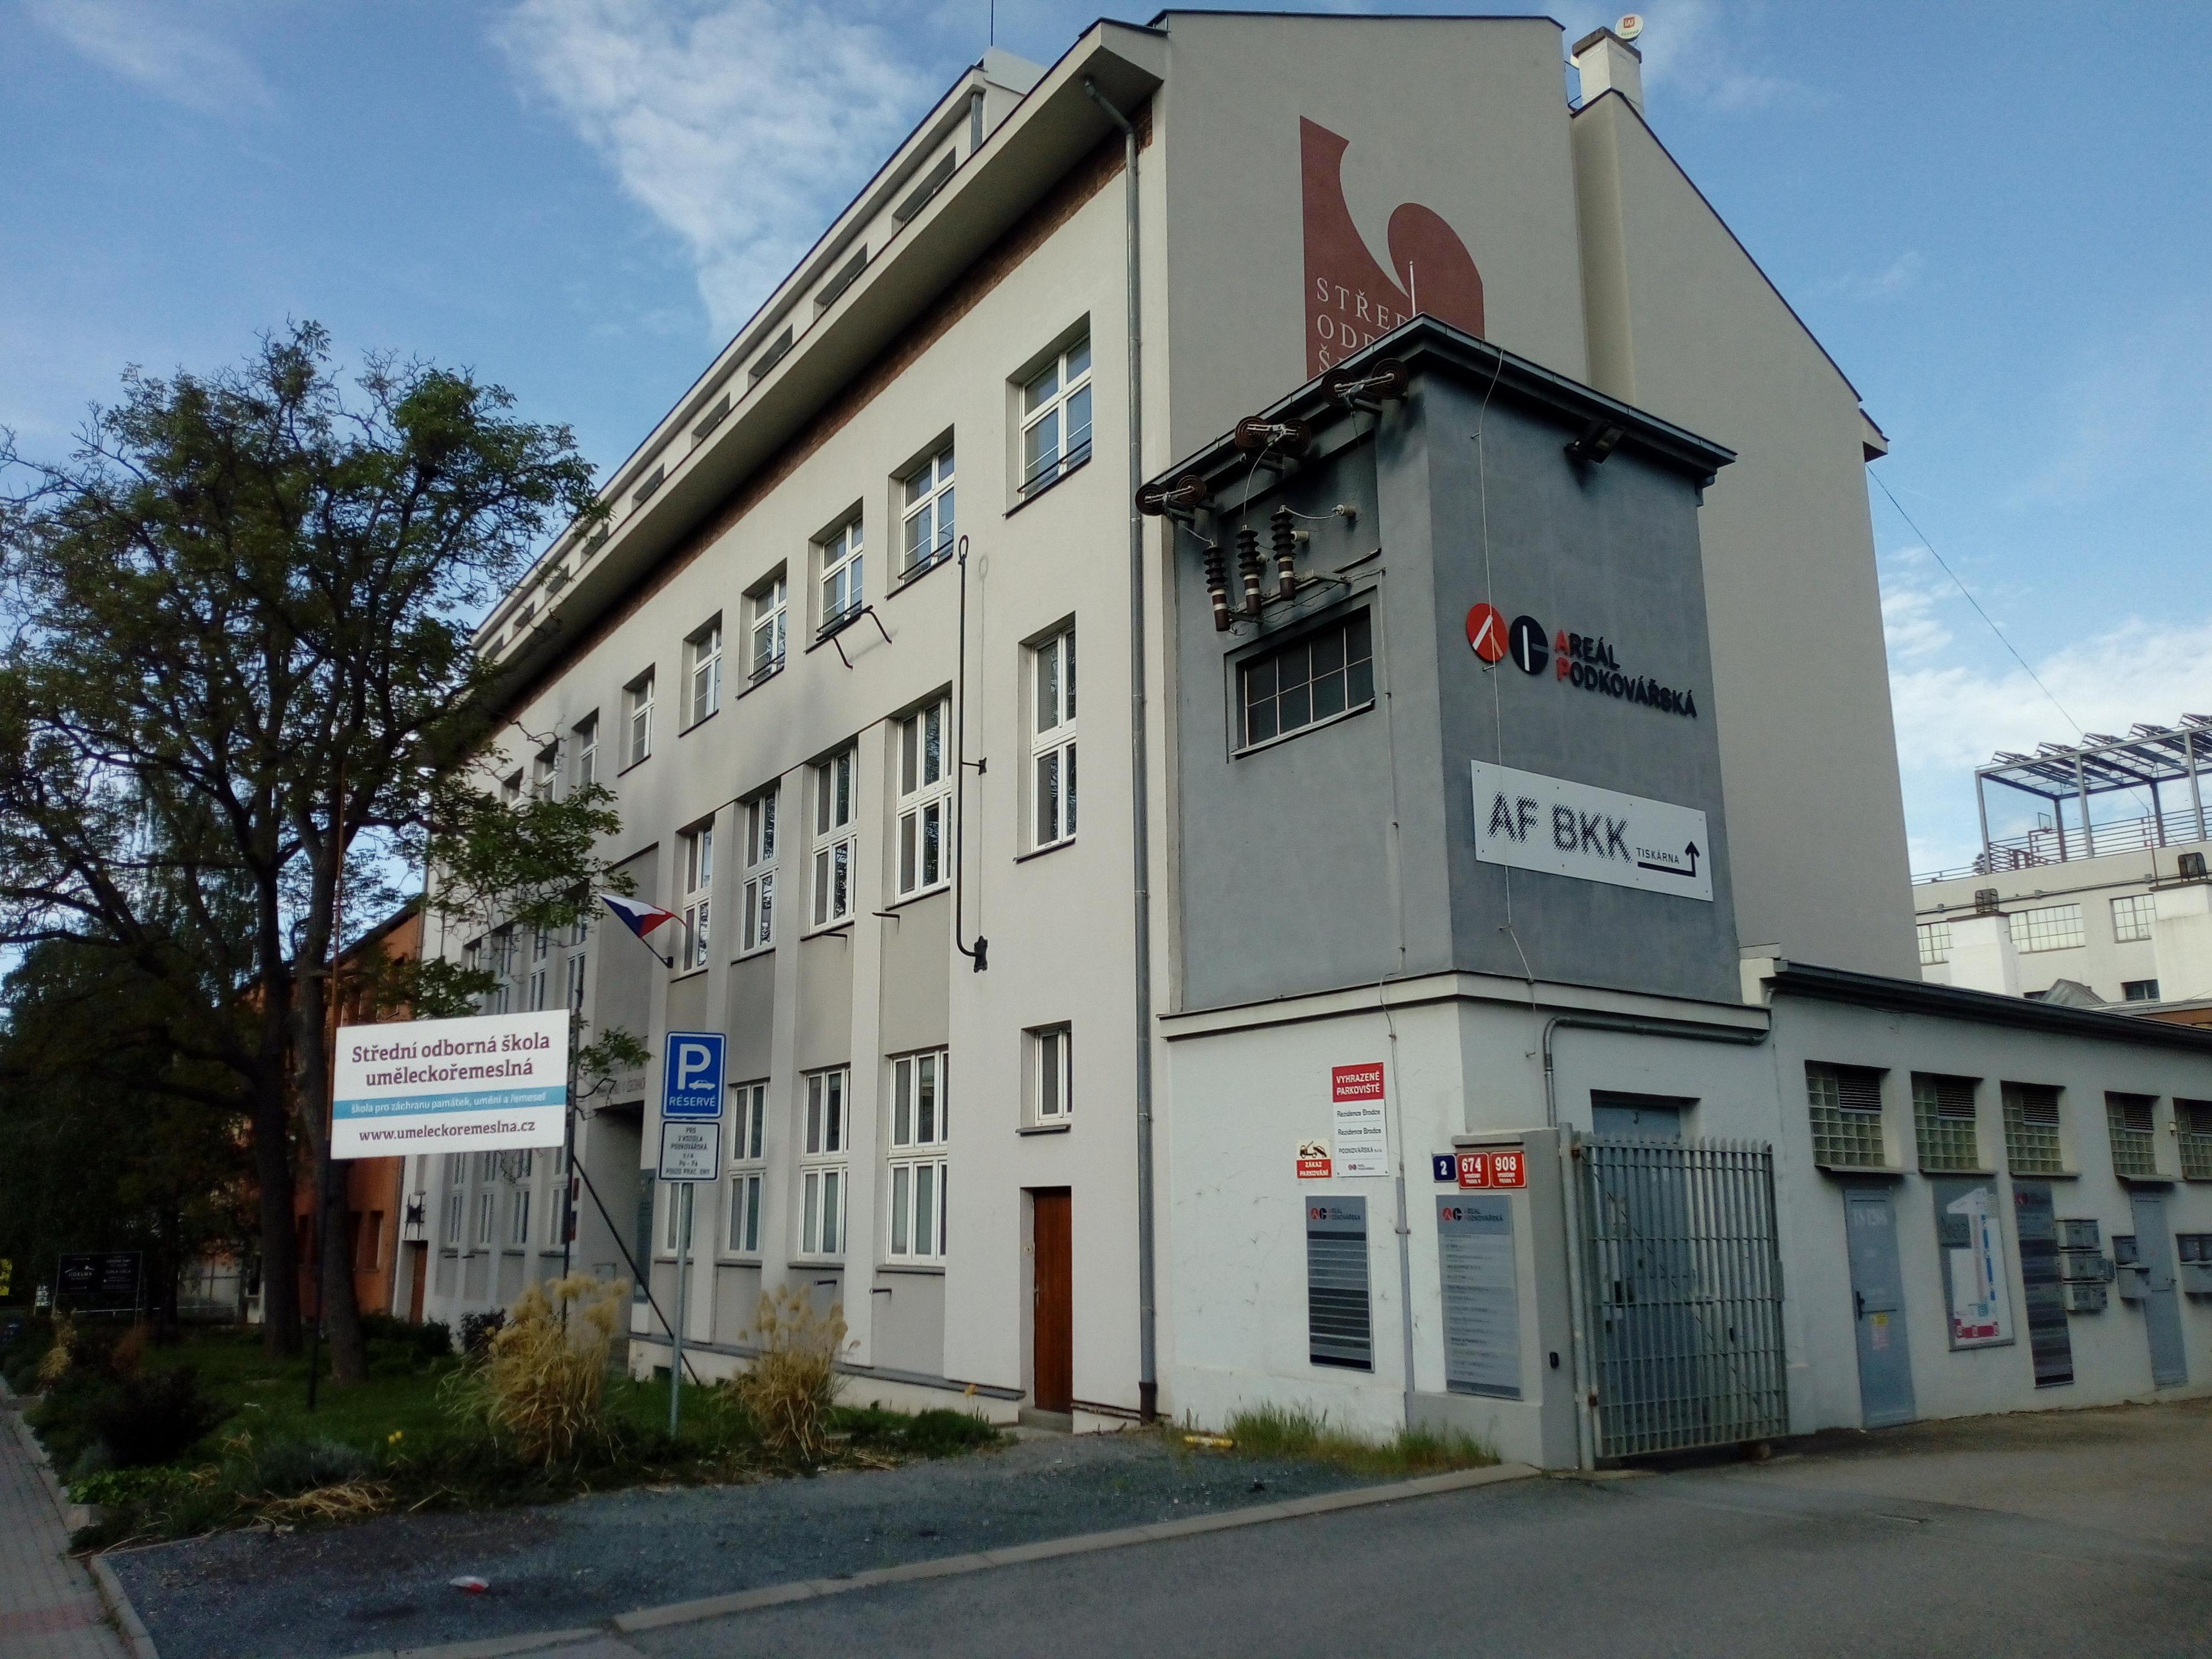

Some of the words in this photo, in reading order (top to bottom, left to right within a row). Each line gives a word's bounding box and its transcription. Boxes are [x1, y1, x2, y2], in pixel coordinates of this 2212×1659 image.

[1554, 629, 1621, 671] AREÁL
[1556, 657, 1698, 718] PODKOVÁŘSKÁ
[1487, 791, 1539, 846] AF
[1550, 803, 1633, 864] BKK
[1636, 847, 1680, 865] TISKÁRNA
[352, 1041, 418, 1063] Střední
[421, 1035, 497, 1057] odborná
[501, 1031, 550, 1052] škola
[366, 1057, 533, 1087] uměleckořemeslná
[677, 1044, 711, 1090] P
[1335, 1070, 1380, 1084] VYHRAZENÉ
[1337, 1082, 1380, 1096] PARKOVIŠTĚ
[351, 1103, 373, 1114] škola
[375, 1104, 389, 1114] pro
[391, 1100, 430, 1111] záchranu
[473, 1095, 501, 1105] umění
[669, 1094, 717, 1107] RÉSERVÉ
[359, 1120, 535, 1141] www.umeleckoremeslna.cz
[1440, 1160, 1448, 1176] 2
[1462, 1157, 1482, 1172] 674
[1495, 1156, 1517, 1172] 908
